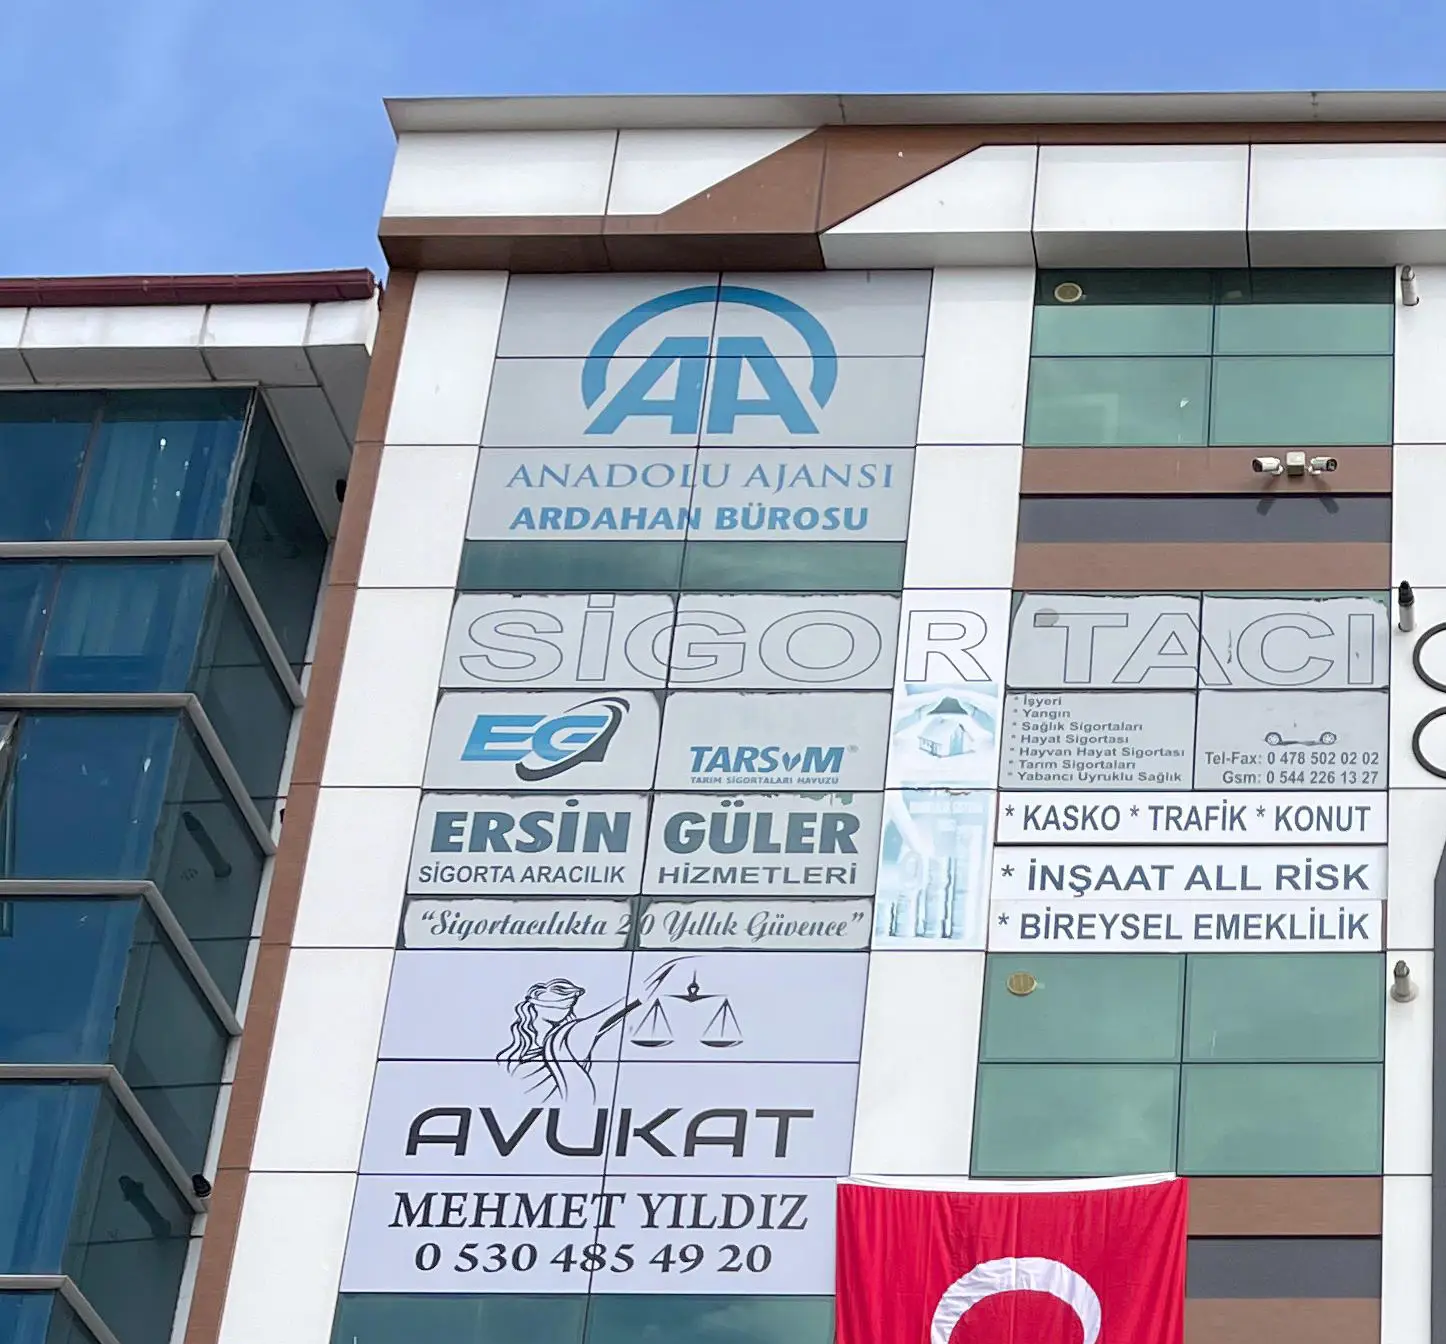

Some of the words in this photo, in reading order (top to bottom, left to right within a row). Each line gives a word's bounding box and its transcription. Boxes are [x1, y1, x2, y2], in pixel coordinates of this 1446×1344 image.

[506, 463, 731, 488] ANADOLU
[741, 463, 893, 495] AJANSI
[509, 507, 700, 530] ARDAHAN
[715, 504, 868, 530] BÜROSU
[1023, 709, 1071, 719] Yangın
[1021, 735, 1060, 745] Hayat
[1065, 735, 1129, 745] Sigortası
[1022, 722, 1064, 732] Sağlık
[1070, 722, 1143, 733] Sigortaları
[1019, 760, 1057, 768] Tarım
[1062, 760, 1136, 770] Sigortaları
[1020, 748, 1071, 758] Hayvan
[1077, 748, 1116, 758] Hayat
[1121, 748, 1185, 758] Sigortası
[1205, 752, 1262, 764] Tel-Fax:
[1280, 752, 1305, 765] 478
[1311, 752, 1335, 765] 502
[1341, 752, 1357, 765] 02
[1362, 752, 1379, 765] 02
[1017, 772, 1073, 781] Yabancı
[1078, 772, 1133, 783] Uyruklu
[1138, 772, 1181, 783] Sağlık
[1222, 772, 1261, 784] Gsm:
[1280, 772, 1304, 784] 544
[1310, 772, 1335, 784] 226
[1341, 772, 1356, 784] 13
[1362, 772, 1378, 784] 27
[430, 799, 631, 853] ERSİN
[663, 800, 860, 854] GÜLER
[1023, 804, 1120, 831] KASKO
[1152, 800, 1247, 831] TRAFİK
[1275, 806, 1370, 832] KONUT
[418, 864, 514, 883] SİGORTA
[520, 866, 625, 883] ARACILIK
[658, 862, 857, 884] HİZMETLERİ
[1028, 859, 1173, 897] İNŞAAT
[1185, 865, 1261, 891] ALL
[1275, 858, 1370, 891] RİSK
[662, 911, 738, 938] Yıllık
[1020, 908, 1182, 940] BİREYSEL
[1194, 908, 1369, 940] EMEKLİLİK
[405, 1107, 814, 1158] AVUKAT
[388, 1192, 625, 1229] MEHMET
[638, 1194, 808, 1229] YILDIZ
[415, 1243, 441, 1271] 0
[454, 1243, 537, 1272] 530
[550, 1244, 634, 1272] 485
[649, 1245, 705, 1272] 49
[717, 1245, 771, 1272] 20
